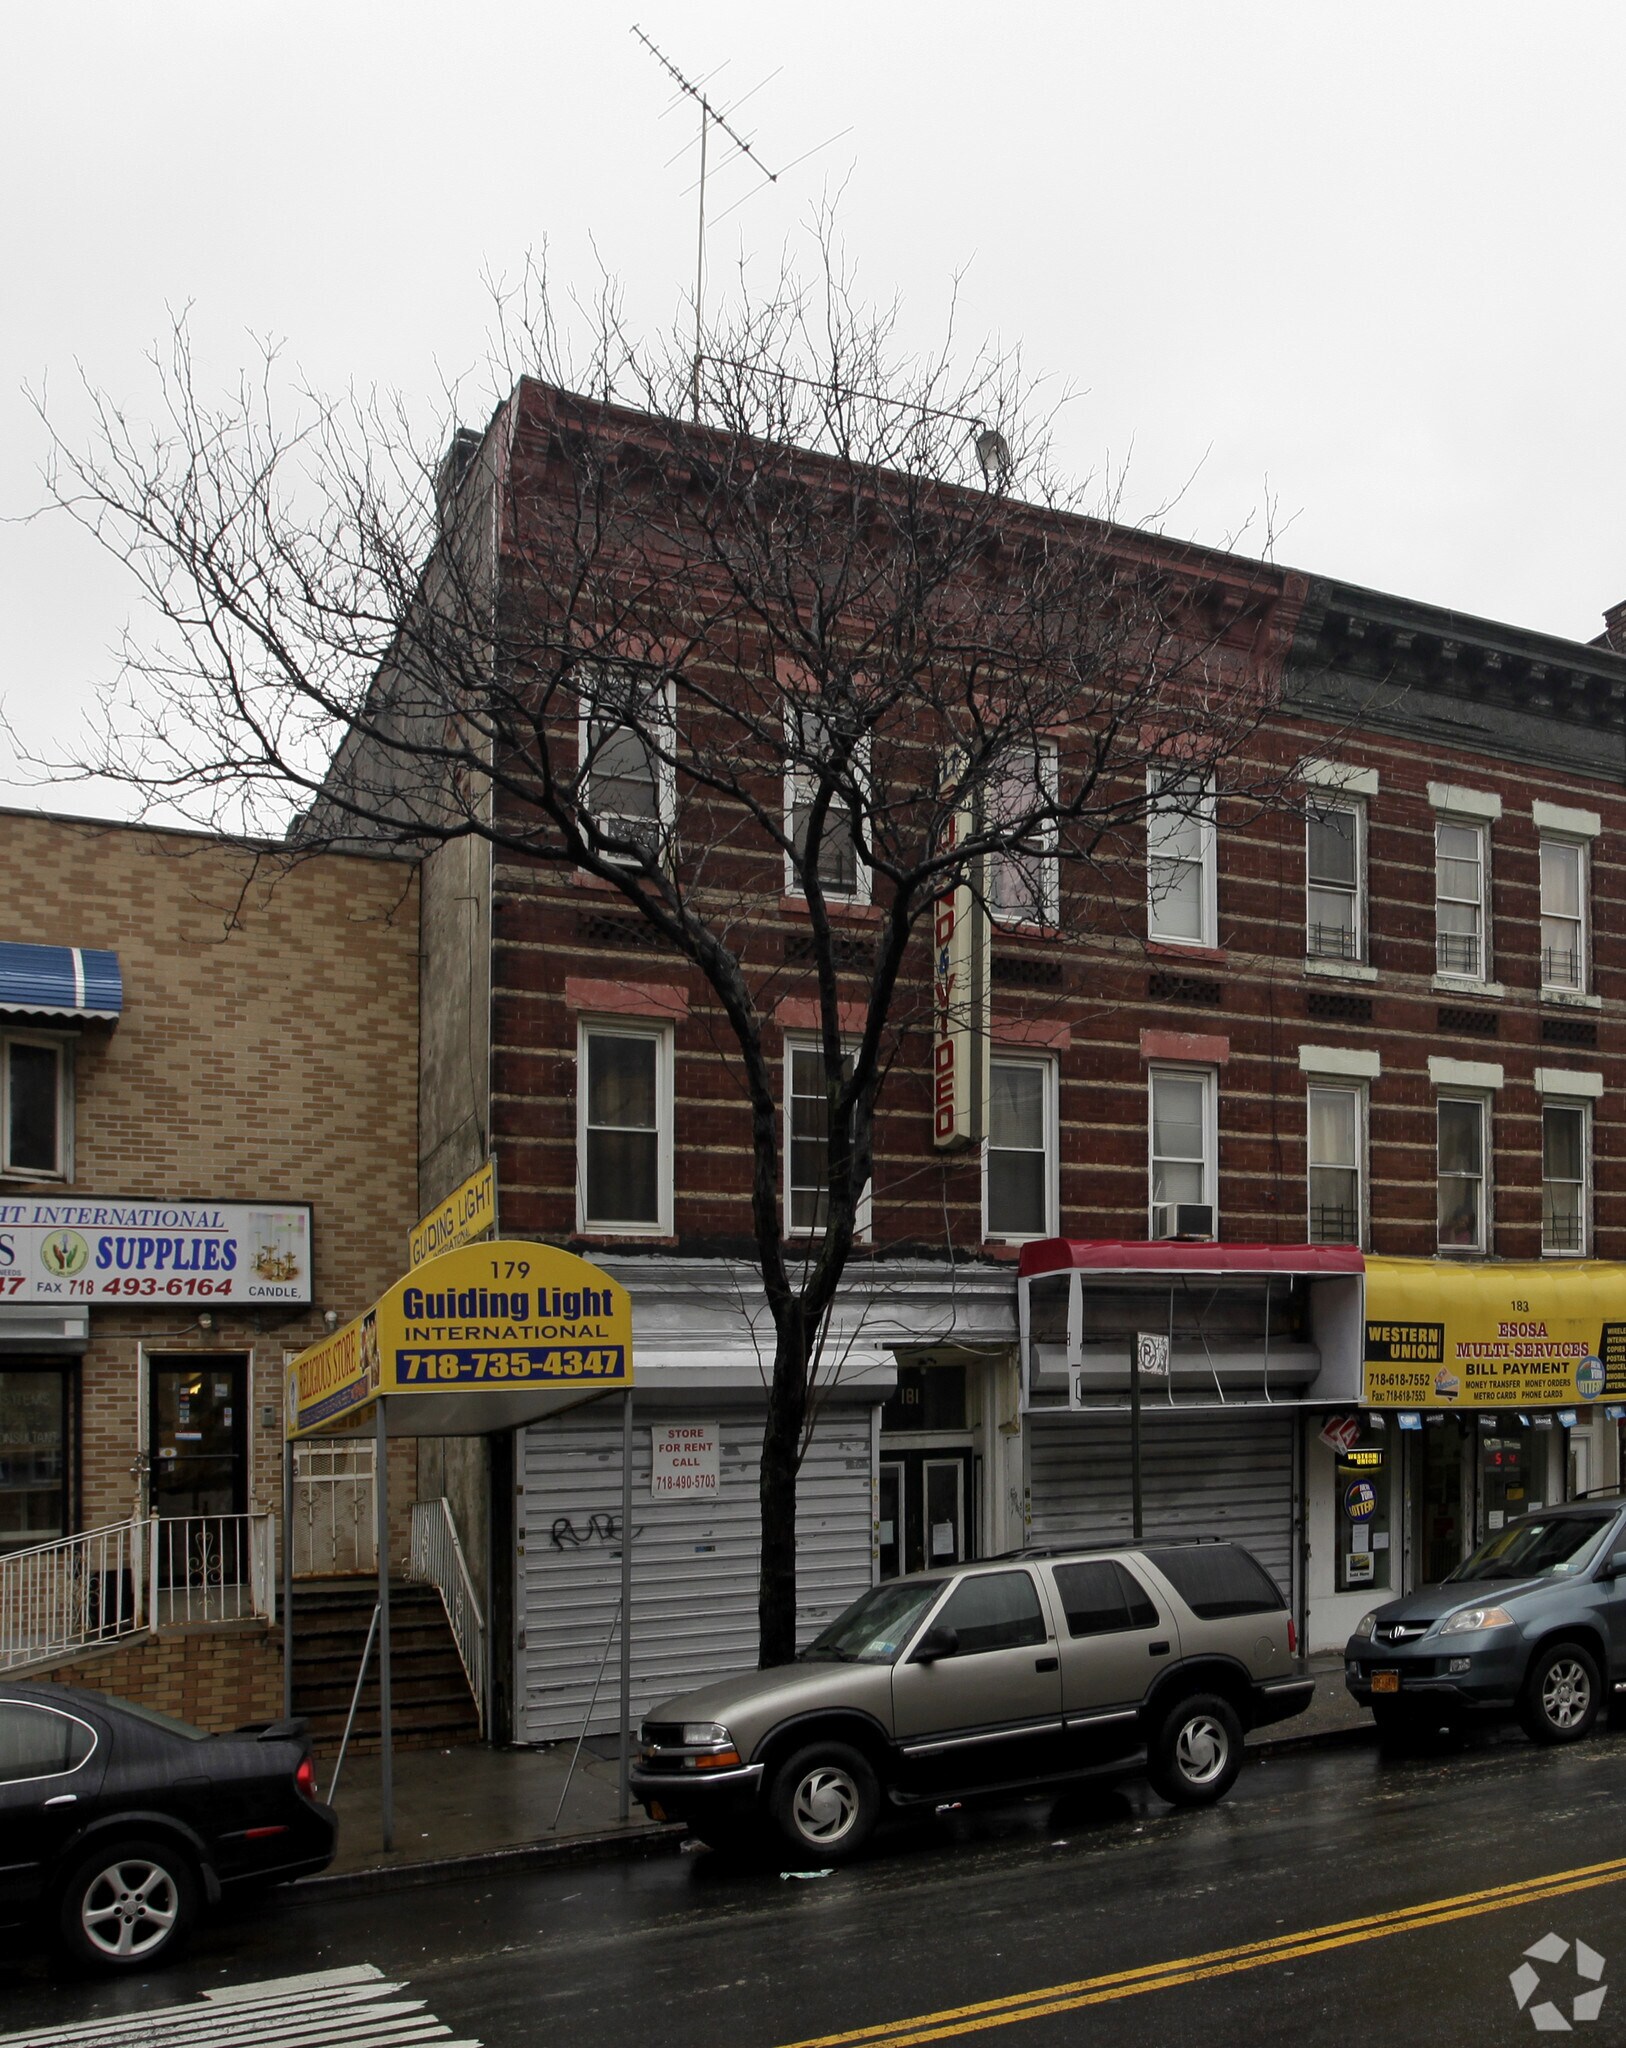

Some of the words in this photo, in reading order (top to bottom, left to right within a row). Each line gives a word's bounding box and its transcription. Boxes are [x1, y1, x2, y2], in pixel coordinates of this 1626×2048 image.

[934, 973, 956, 1138] VIDEO
[32, 1207, 225, 1229] INTERNATIONAL
[413, 1207, 454, 1265] GUIDING
[458, 1174, 492, 1227] LIGHT
[95, 1236, 238, 1272] SUPPLIES
[490, 1262, 531, 1279] 179
[36, 1281, 62, 1294] FAX
[69, 1280, 94, 1295] 718
[102, 1277, 233, 1297] 493-6164
[248, 1286, 302, 1299] CANDLE,
[403, 1287, 530, 1322] Guiding
[538, 1287, 614, 1321] Light
[1510, 1300, 1530, 1313] 183
[405, 1325, 609, 1341] INTERNATIONAL
[1368, 1326, 1438, 1343] WESTERN
[1498, 1322, 1549, 1338] ESOSA
[1390, 1343, 1438, 1360] UNION
[1456, 1341, 1590, 1359] MULTI-SERVICES
[299, 1348, 331, 1402] RELIGIOUS
[333, 1329, 357, 1385] STORE
[403, 1350, 618, 1380] 718-735-4347
[1466, 1363, 1498, 1375] BILL
[1503, 1362, 1570, 1375] PAYMENT
[1369, 1373, 1430, 1386] 718-618-7552
[1465, 1380, 1488, 1389] MONEY
[1489, 1380, 1521, 1389] TRANSFER
[1525, 1379, 1546, 1388] MONEY
[1547, 1379, 1571, 1387] ORDERS
[902, 1389, 919, 1404] 181
[1372, 1390, 1385, 1401] Fax:
[1473, 1392, 1495, 1400] METRO
[1496, 1391, 1517, 1400] CARDS
[1521, 1391, 1541, 1399] PHONE
[1543, 1390, 1563, 1398] CARDS
[668, 1429, 704, 1438] STORE
[659, 1444, 681, 1453] FOR
[684, 1443, 712, 1452] RENT
[672, 1458, 700, 1467] CALL
[656, 1475, 716, 1490] 718-490-5703
